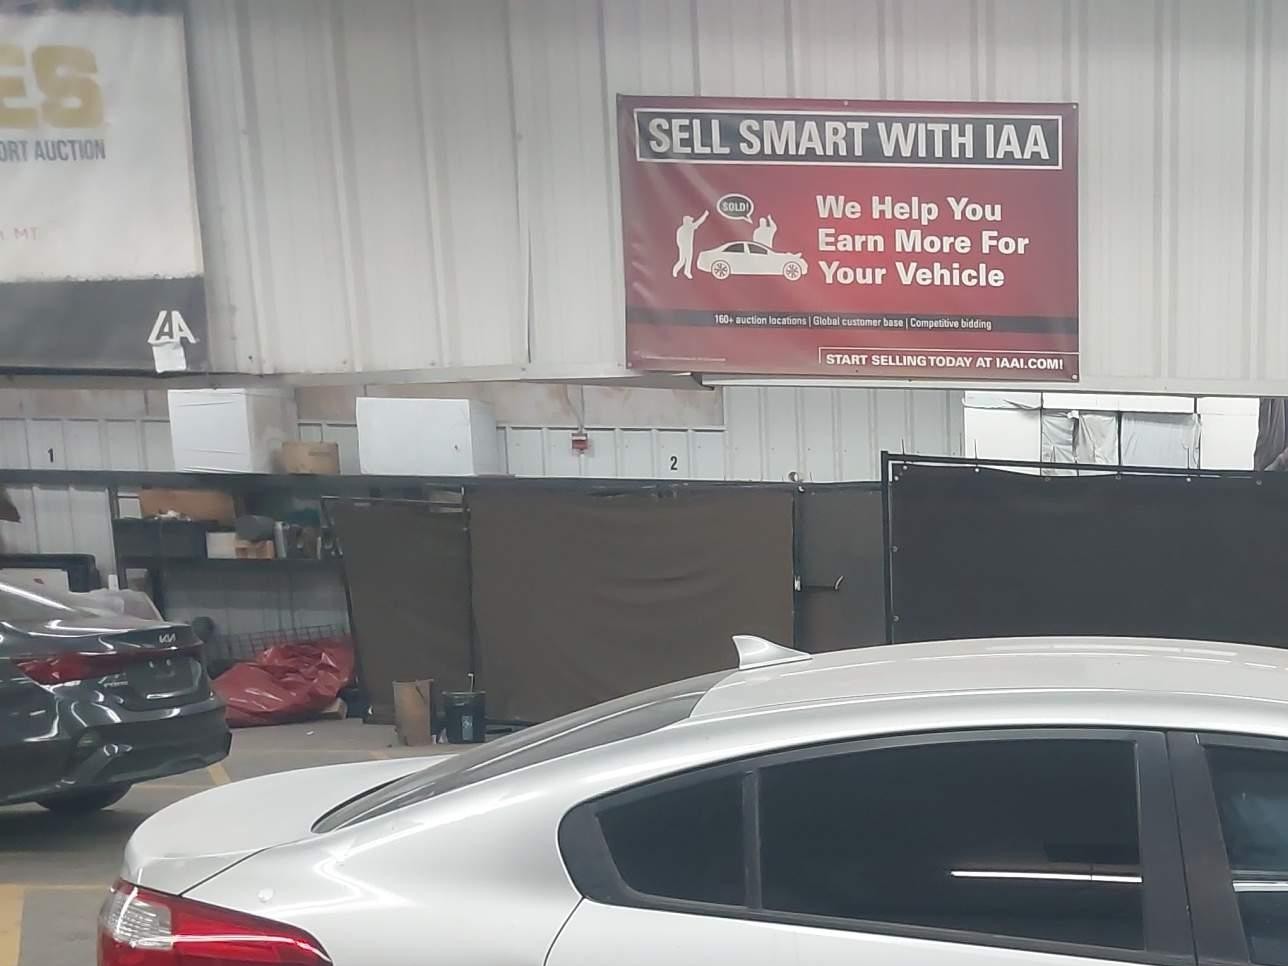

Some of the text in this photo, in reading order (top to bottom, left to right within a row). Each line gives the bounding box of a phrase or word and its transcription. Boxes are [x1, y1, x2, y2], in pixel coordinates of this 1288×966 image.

[649, 118, 1050, 160] SELL SMART WITH IAA
[34, 139, 106, 161] AUCTION
[722, 202, 749, 212] SOLD!
[816, 195, 1001, 225] We Help You
[818, 228, 1030, 254] Earn More For
[818, 261, 1005, 286] Your Vehicle
[714, 314, 734, 325] 160+
[736, 315, 767, 325] auction
[768, 315, 807, 326] locations
[813, 316, 840, 327] Global
[842, 318, 881, 327] customer
[883, 317, 903, 327] base
[910, 318, 959, 330] Competitive
[961, 319, 992, 331] bidding
[826, 354, 1063, 370] START SELLING TODAY AT IAAI.COM!
[48, 448, 54, 464] 1
[670, 455, 678, 471] 2
